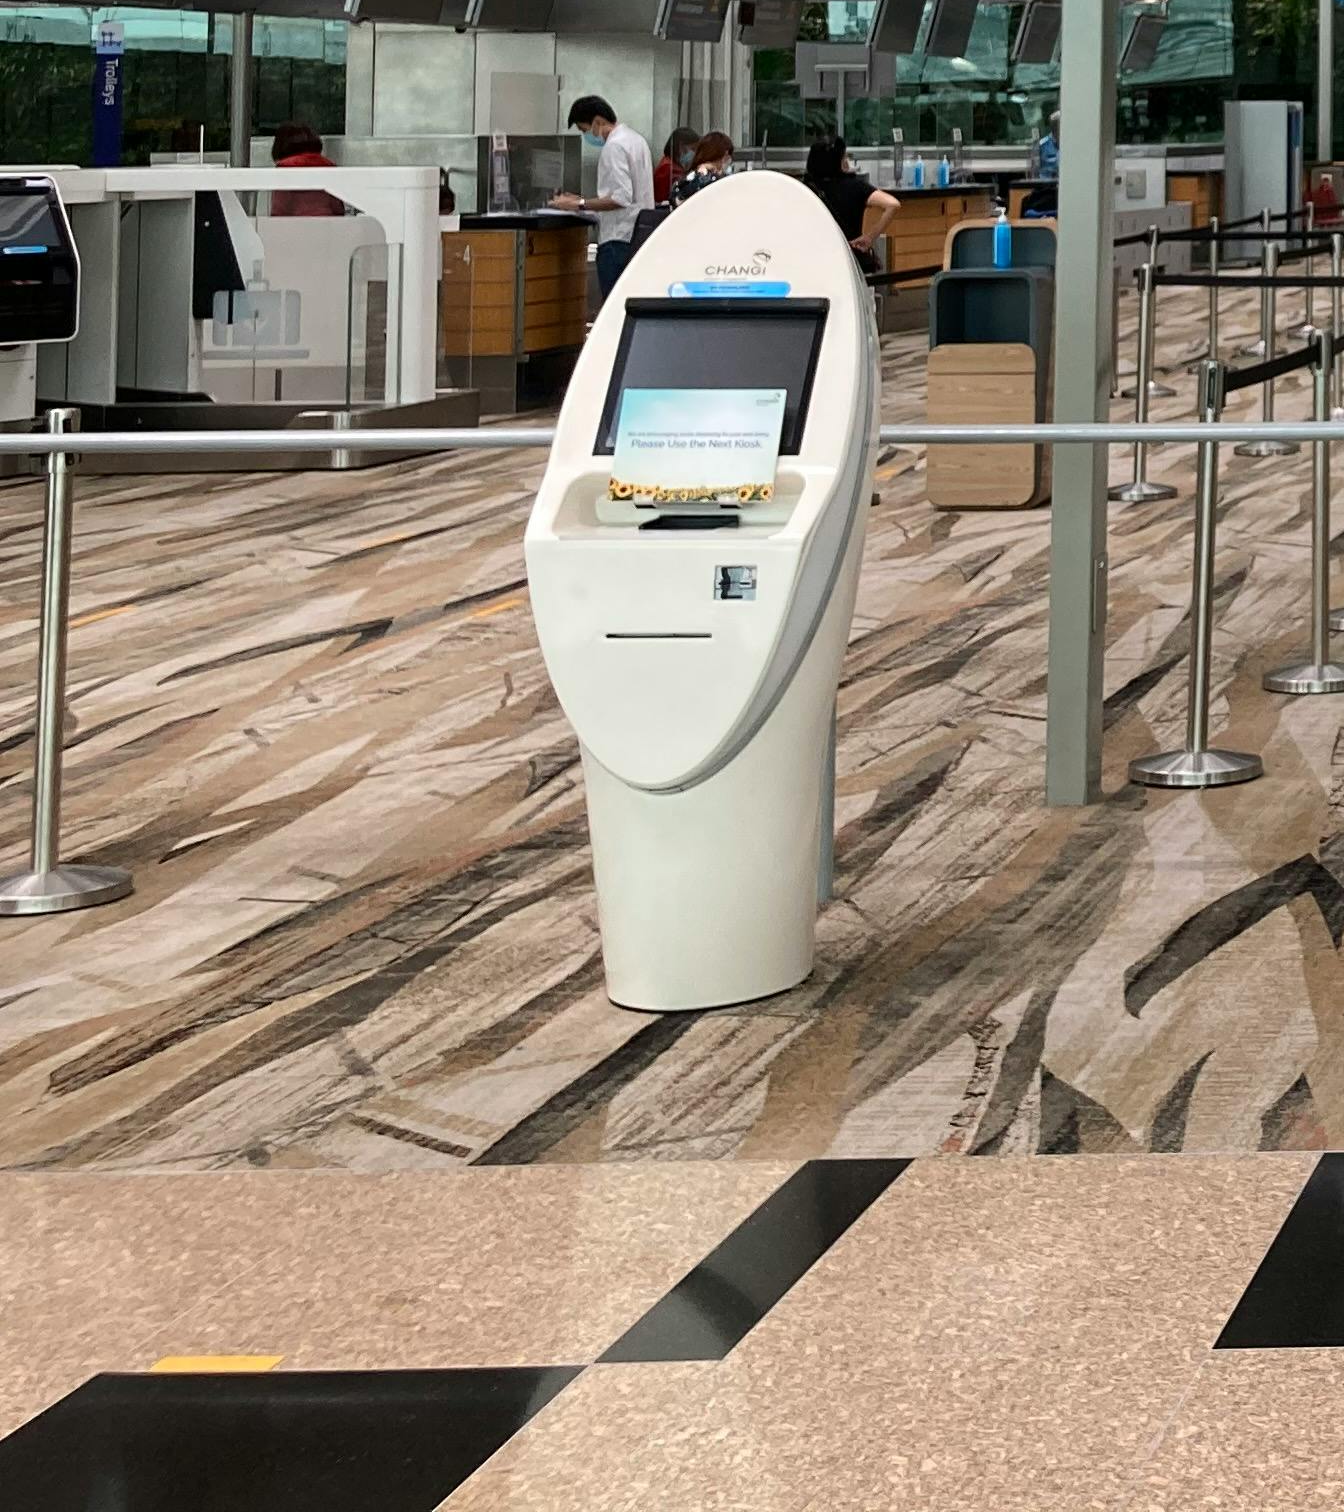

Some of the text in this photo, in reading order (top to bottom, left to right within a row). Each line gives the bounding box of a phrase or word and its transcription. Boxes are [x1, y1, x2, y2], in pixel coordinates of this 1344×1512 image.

[102, 59, 118, 105] Trolleys
[705, 266, 766, 275] CHANGI
[632, 439, 665, 448] Please
[668, 440, 687, 448] Use
[690, 440, 706, 448] the
[709, 440, 731, 448] Next
